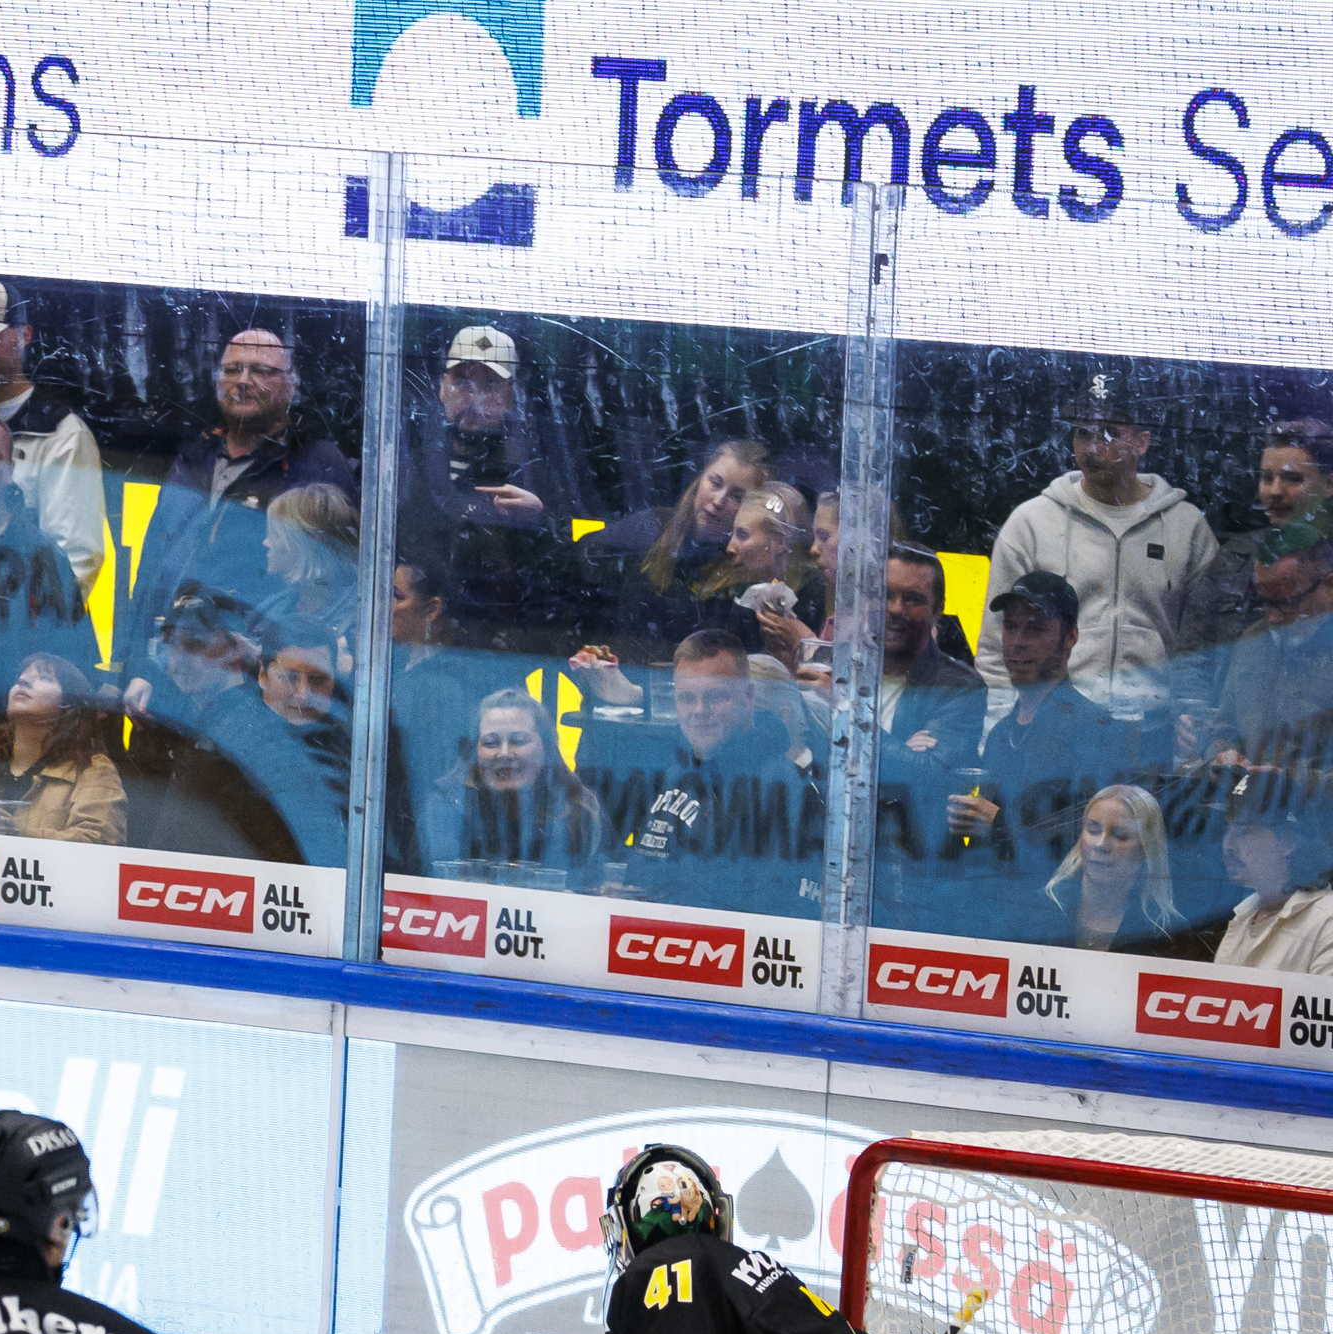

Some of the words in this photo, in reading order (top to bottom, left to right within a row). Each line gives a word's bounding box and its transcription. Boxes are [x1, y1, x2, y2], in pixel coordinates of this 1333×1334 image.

[589, 56, 1126, 224] Tormets
[2, 857, 45, 881] ALL
[0, 881, 54, 909] OUT.
[126, 881, 247, 917] CCM
[263, 884, 304, 909] ALL
[262, 908, 313, 935] OUT.
[495, 908, 538, 934] ALL
[494, 933, 545, 961] OUT.
[615, 933, 738, 971] CCM
[753, 937, 796, 963] ALL
[752, 962, 804, 990] OUT.
[876, 961, 1001, 1000] CCM
[1017, 966, 1062, 993] ALL
[1016, 991, 1071, 1020] OUT.
[1144, 991, 1275, 1031] CCM
[1290, 1021, 1333, 1049] OU
[644, 1259, 694, 1311] 41
